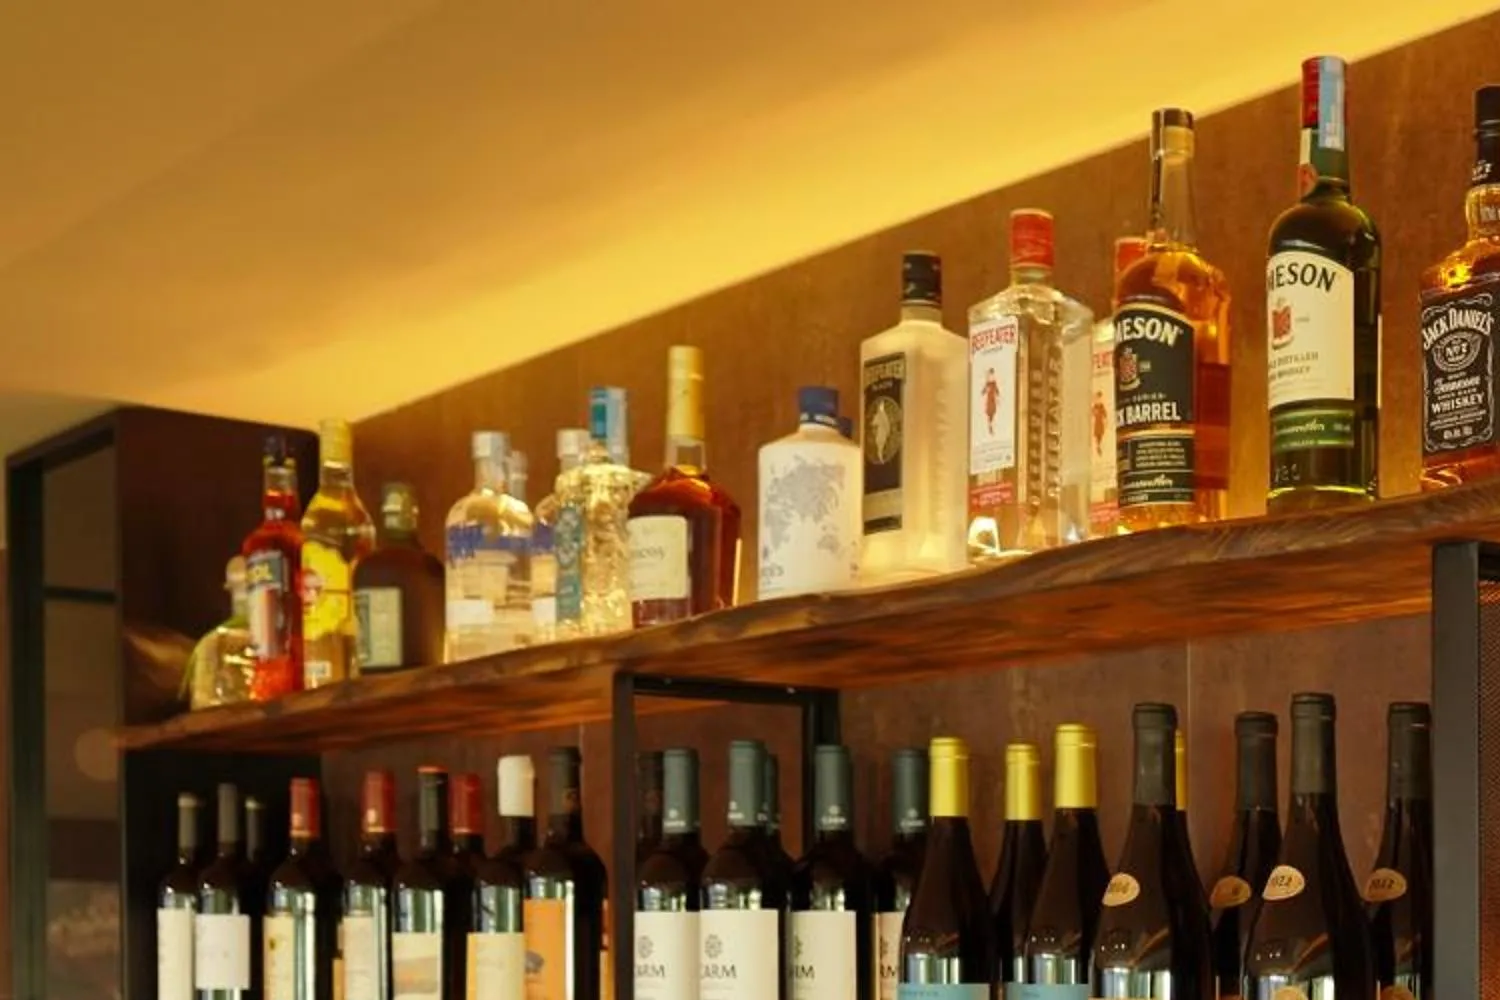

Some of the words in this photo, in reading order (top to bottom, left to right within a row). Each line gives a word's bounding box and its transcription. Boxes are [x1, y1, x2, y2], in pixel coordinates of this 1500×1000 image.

[1422, 315, 1449, 351] JACK
[1448, 307, 1494, 336] DANIEL'S
[1126, 402, 1182, 425] BARREL
[1431, 392, 1485, 414] WHISKEY
